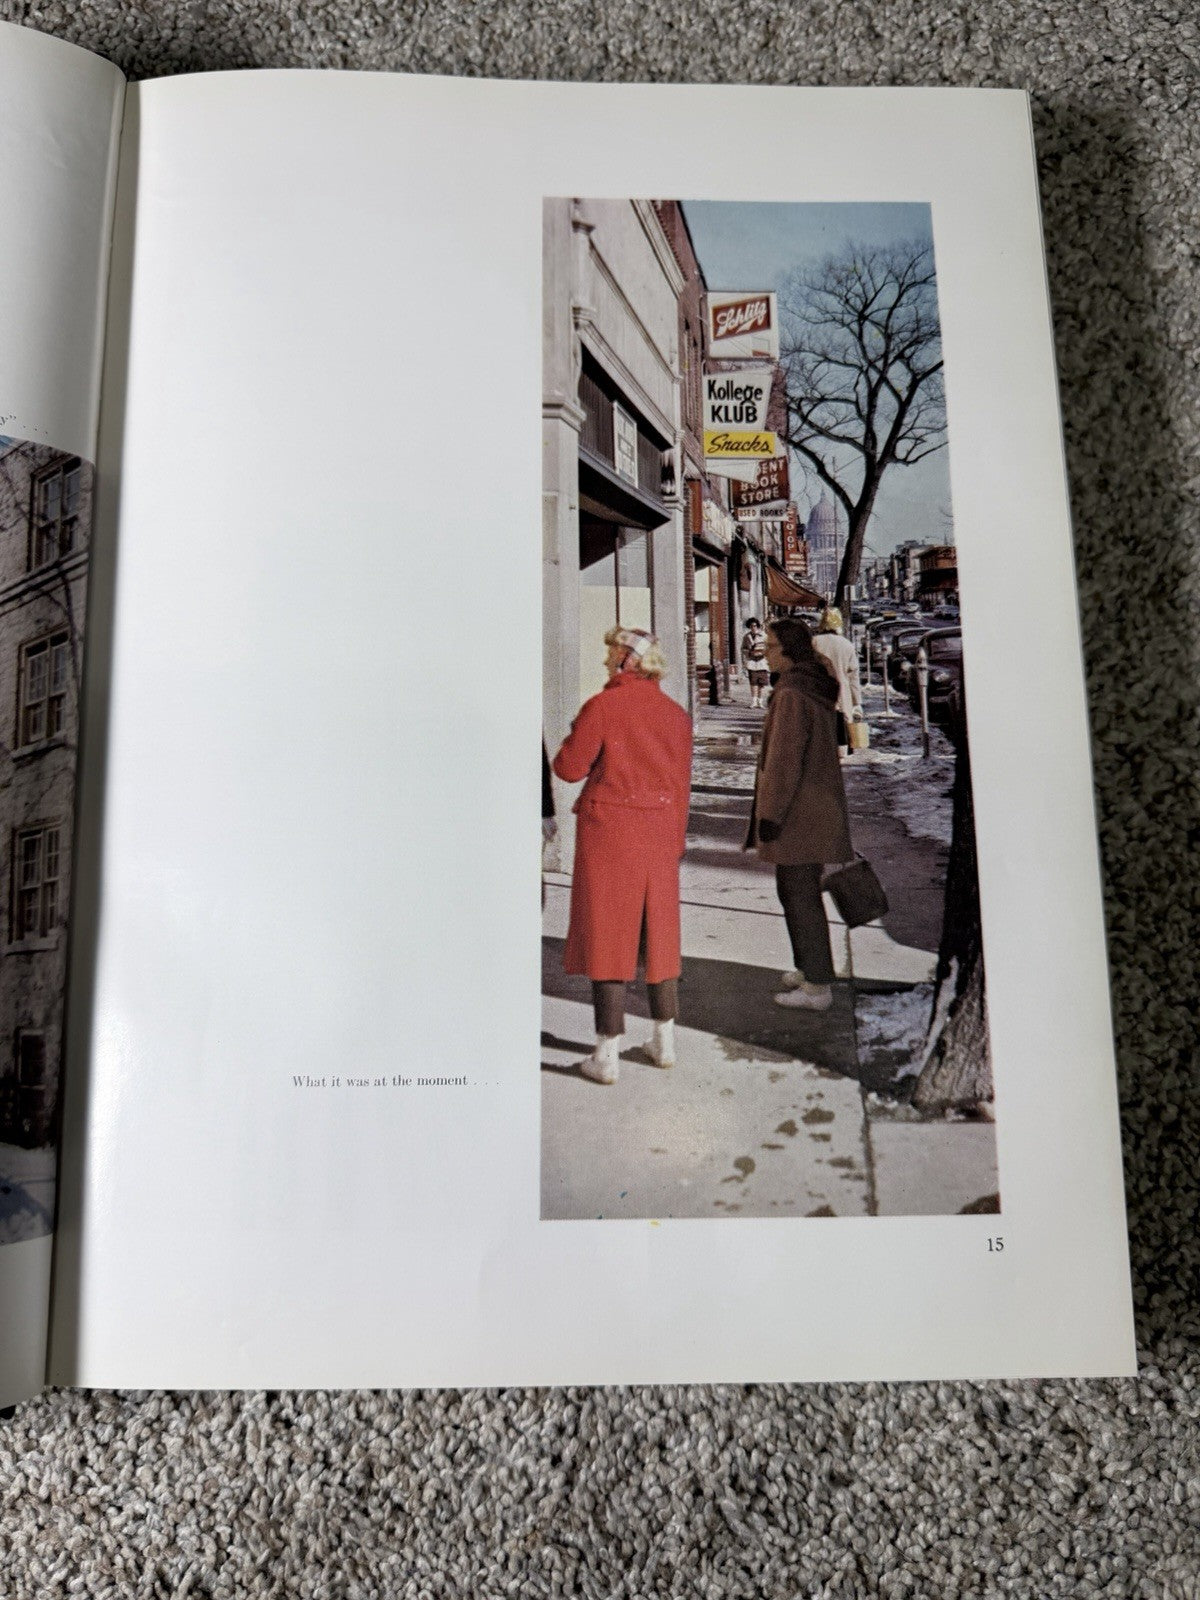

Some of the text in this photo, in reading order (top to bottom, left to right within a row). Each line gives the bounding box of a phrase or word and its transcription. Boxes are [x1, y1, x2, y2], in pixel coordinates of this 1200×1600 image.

[716, 301, 767, 337] Schlitz
[707, 379, 763, 406] Kollege
[711, 404, 758, 423] KLUB
[707, 433, 773, 454] Snacks
[761, 459, 785, 474] ENT
[740, 486, 780, 505] STORE
[738, 509, 783, 517] USED BOOKS
[293, 1075, 327, 1087] What
[331, 1075, 341, 1087] it
[347, 1078, 370, 1087] was
[373, 1075, 388, 1087] at
[392, 1074, 412, 1086] the
[417, 1075, 469, 1086] moment
[987, 1237, 1004, 1252] 15
